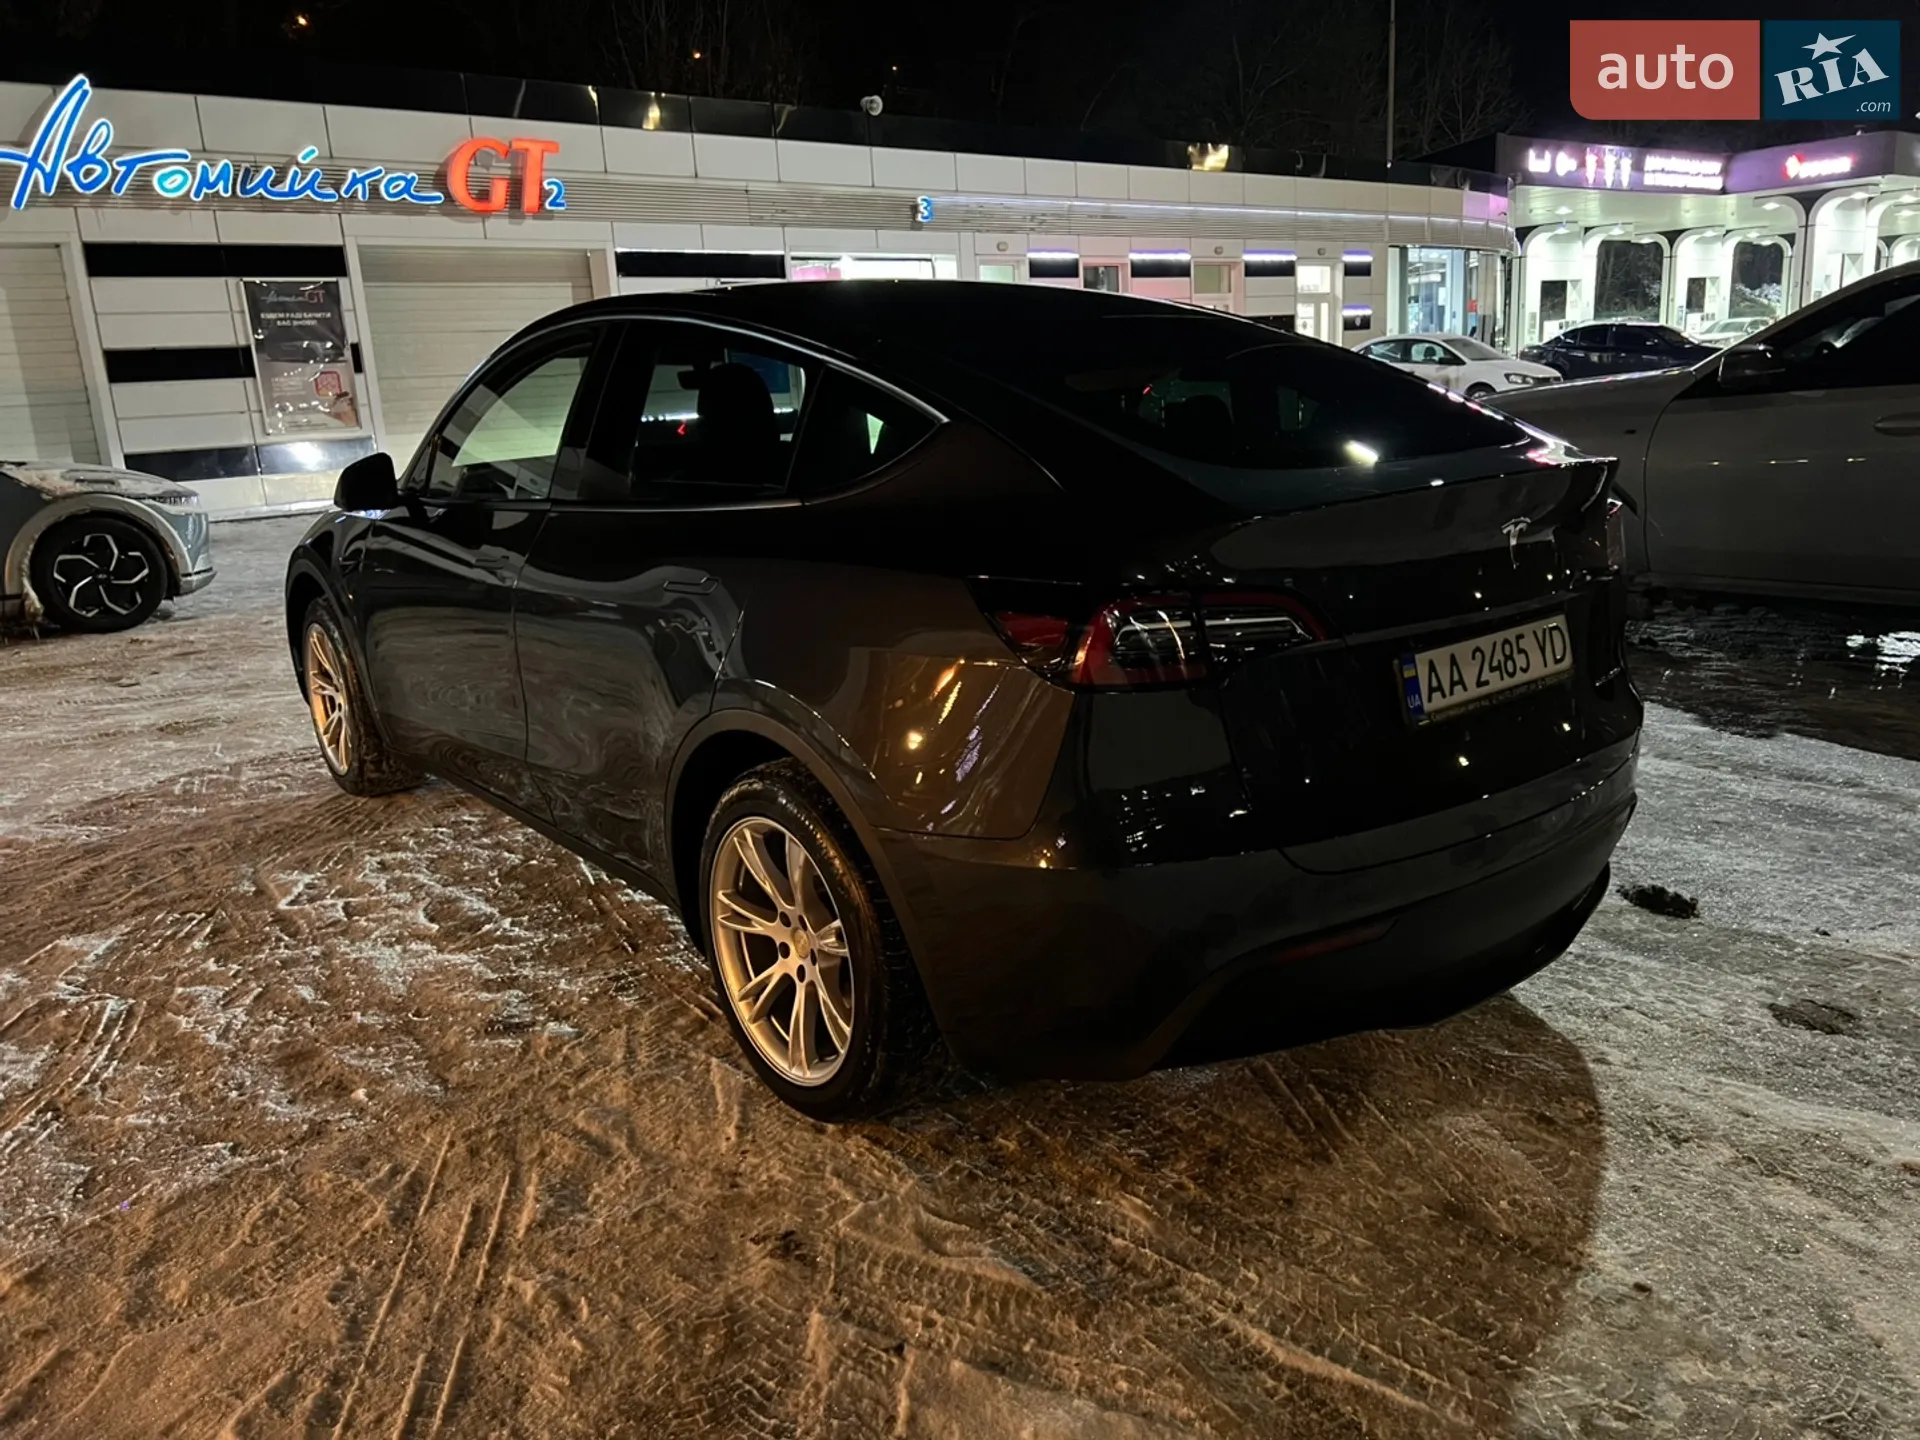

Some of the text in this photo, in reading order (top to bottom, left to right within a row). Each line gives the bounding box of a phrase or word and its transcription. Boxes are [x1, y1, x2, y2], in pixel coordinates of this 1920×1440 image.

[0, 73, 445, 211] Автомийка
[916, 195, 935, 223] 3
[1427, 652, 1468, 704] AA
[1471, 633, 1531, 690] 2485
[1532, 623, 1567, 669] YD
[1406, 694, 1422, 709] UA
